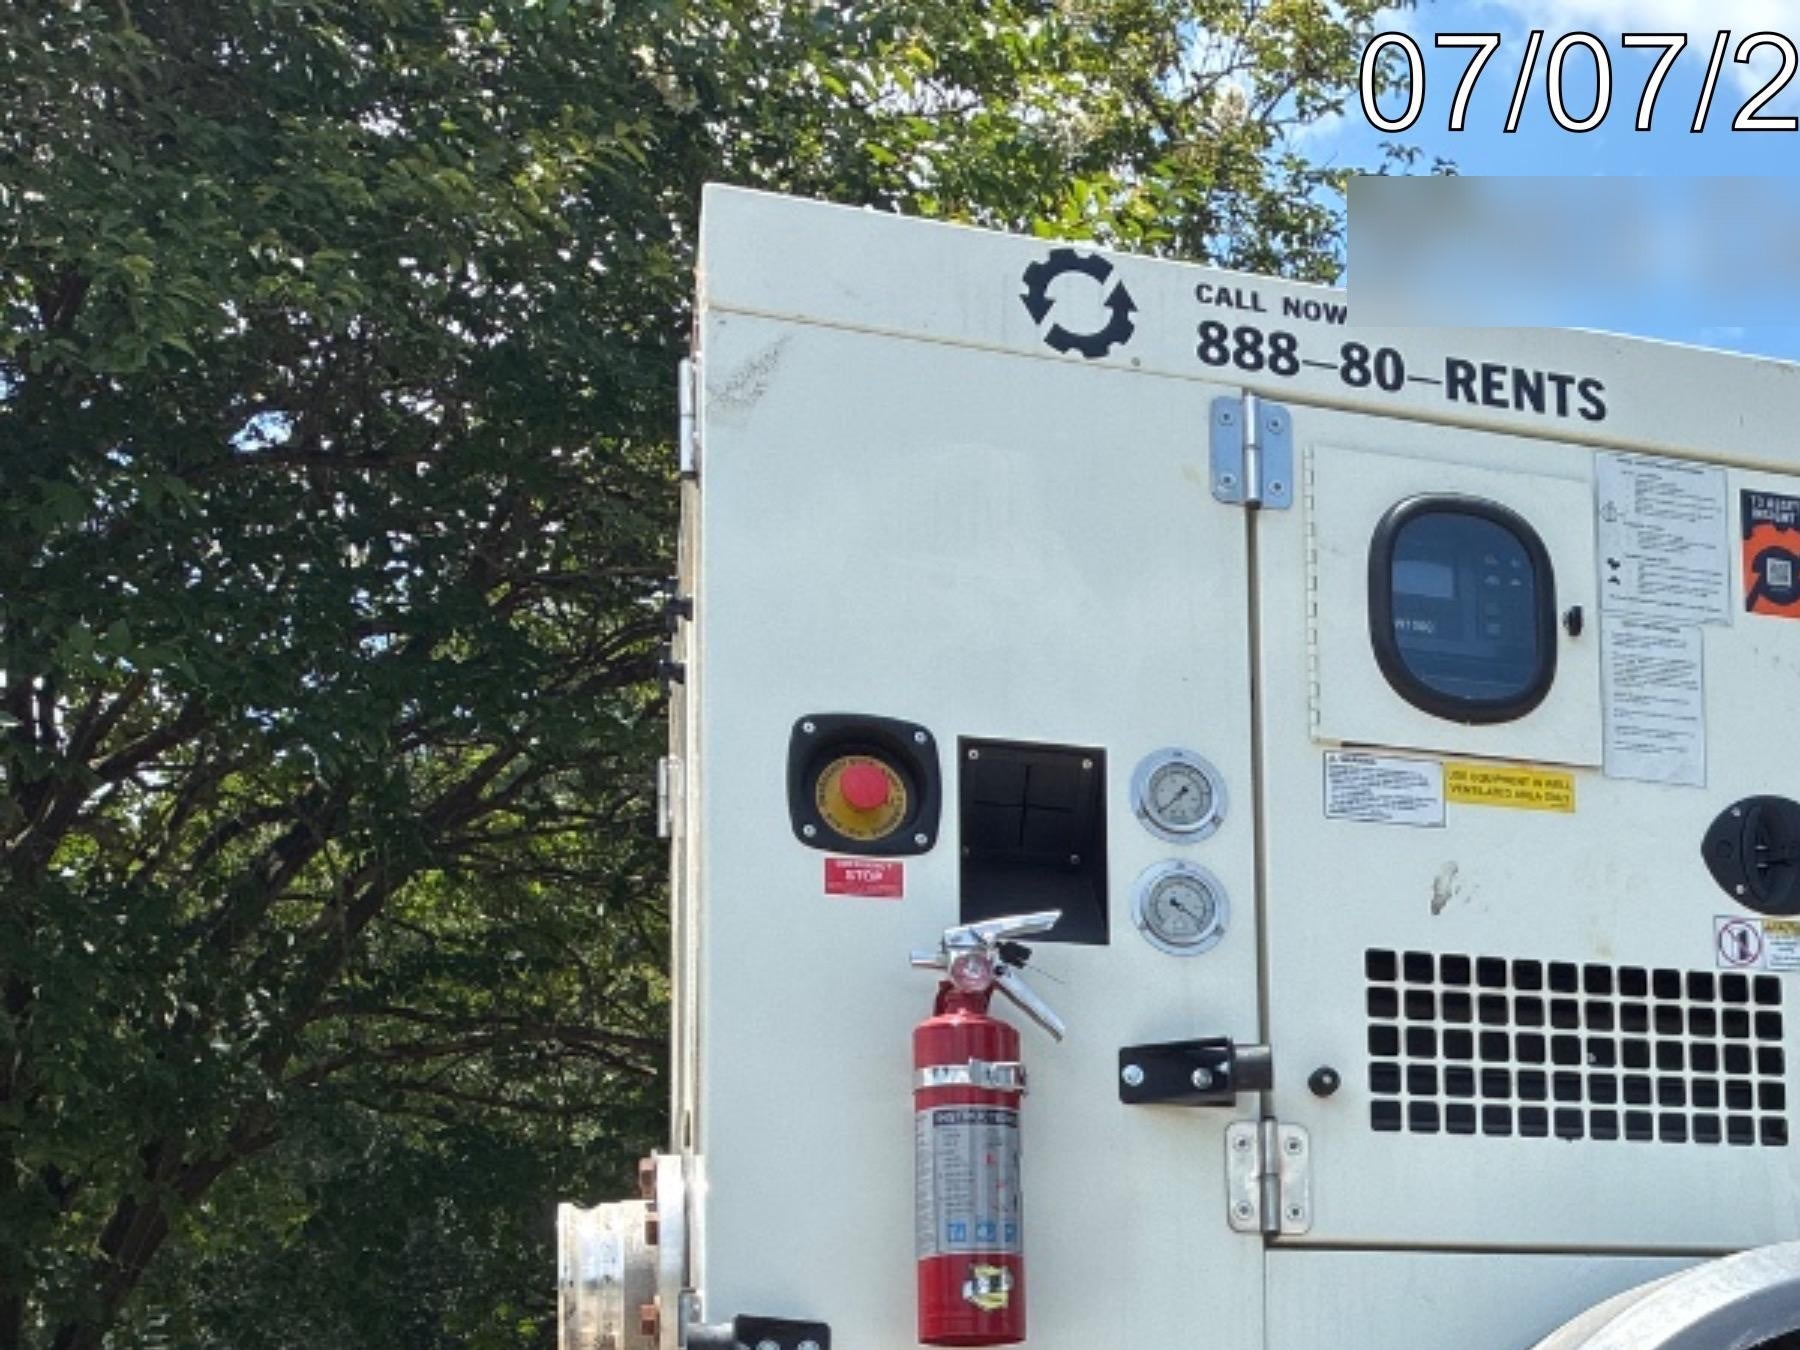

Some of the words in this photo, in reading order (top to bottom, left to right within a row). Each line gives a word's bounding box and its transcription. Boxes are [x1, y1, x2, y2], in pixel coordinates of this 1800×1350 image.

[1196, 283, 1267, 314] CALL
[1282, 296, 1347, 326] NOW
[845, 868, 884, 882] STOP
